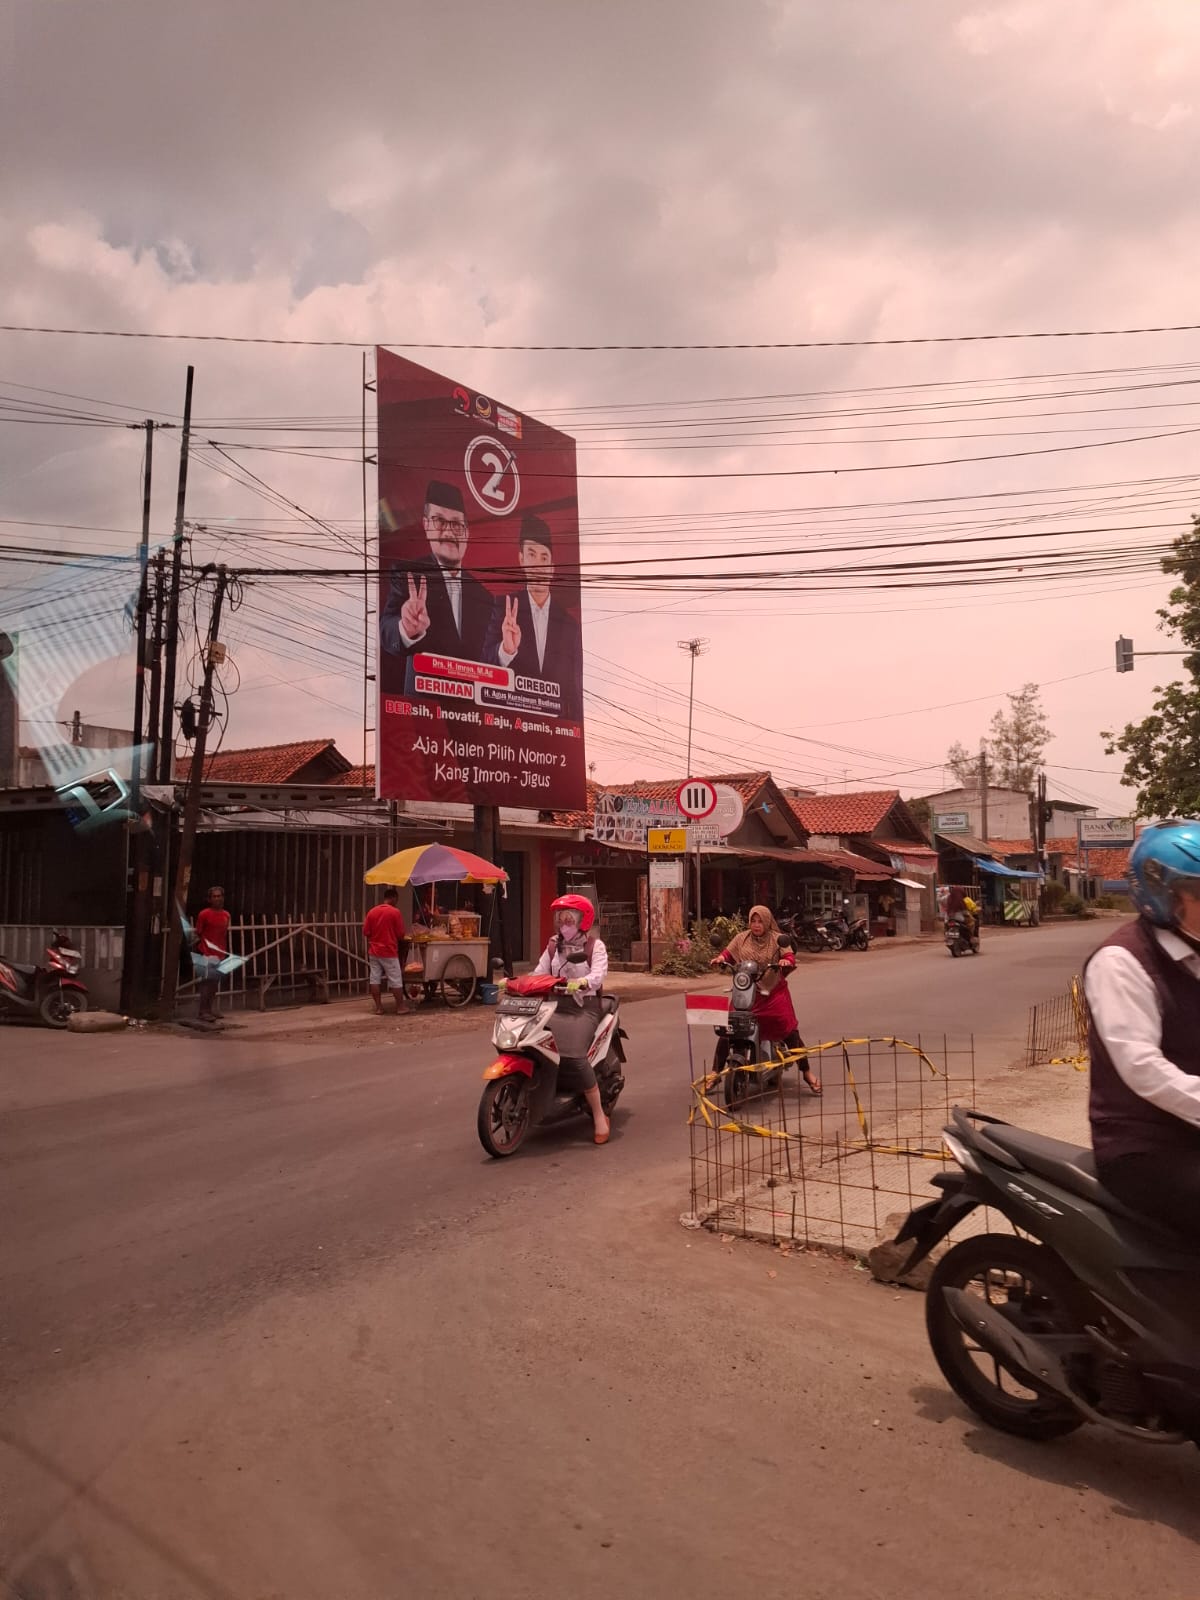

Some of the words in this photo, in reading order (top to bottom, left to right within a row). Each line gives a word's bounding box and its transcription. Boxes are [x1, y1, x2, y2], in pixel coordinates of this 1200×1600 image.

[481, 452, 505, 502] 2
[432, 658, 446, 668] Drs.
[415, 676, 474, 699] BERIMAN
[484, 688, 491, 698] H.
[491, 689, 507, 700] Agus
[515, 676, 560, 697] CIREBON
[385, 700, 433, 719] BERsih,
[436, 706, 482, 726] Inovatif,
[484, 712, 512, 730] Maju,
[514, 717, 553, 735] Agamis,
[411, 735, 438, 755] Aja
[442, 738, 485, 758] Klalen
[487, 743, 515, 762] Pilih
[518, 747, 558, 765] Nomor
[560, 754, 567, 767] 2
[434, 762, 470, 783] Kang
[472, 766, 510, 784] Imron
[520, 770, 551, 788] Jigus
